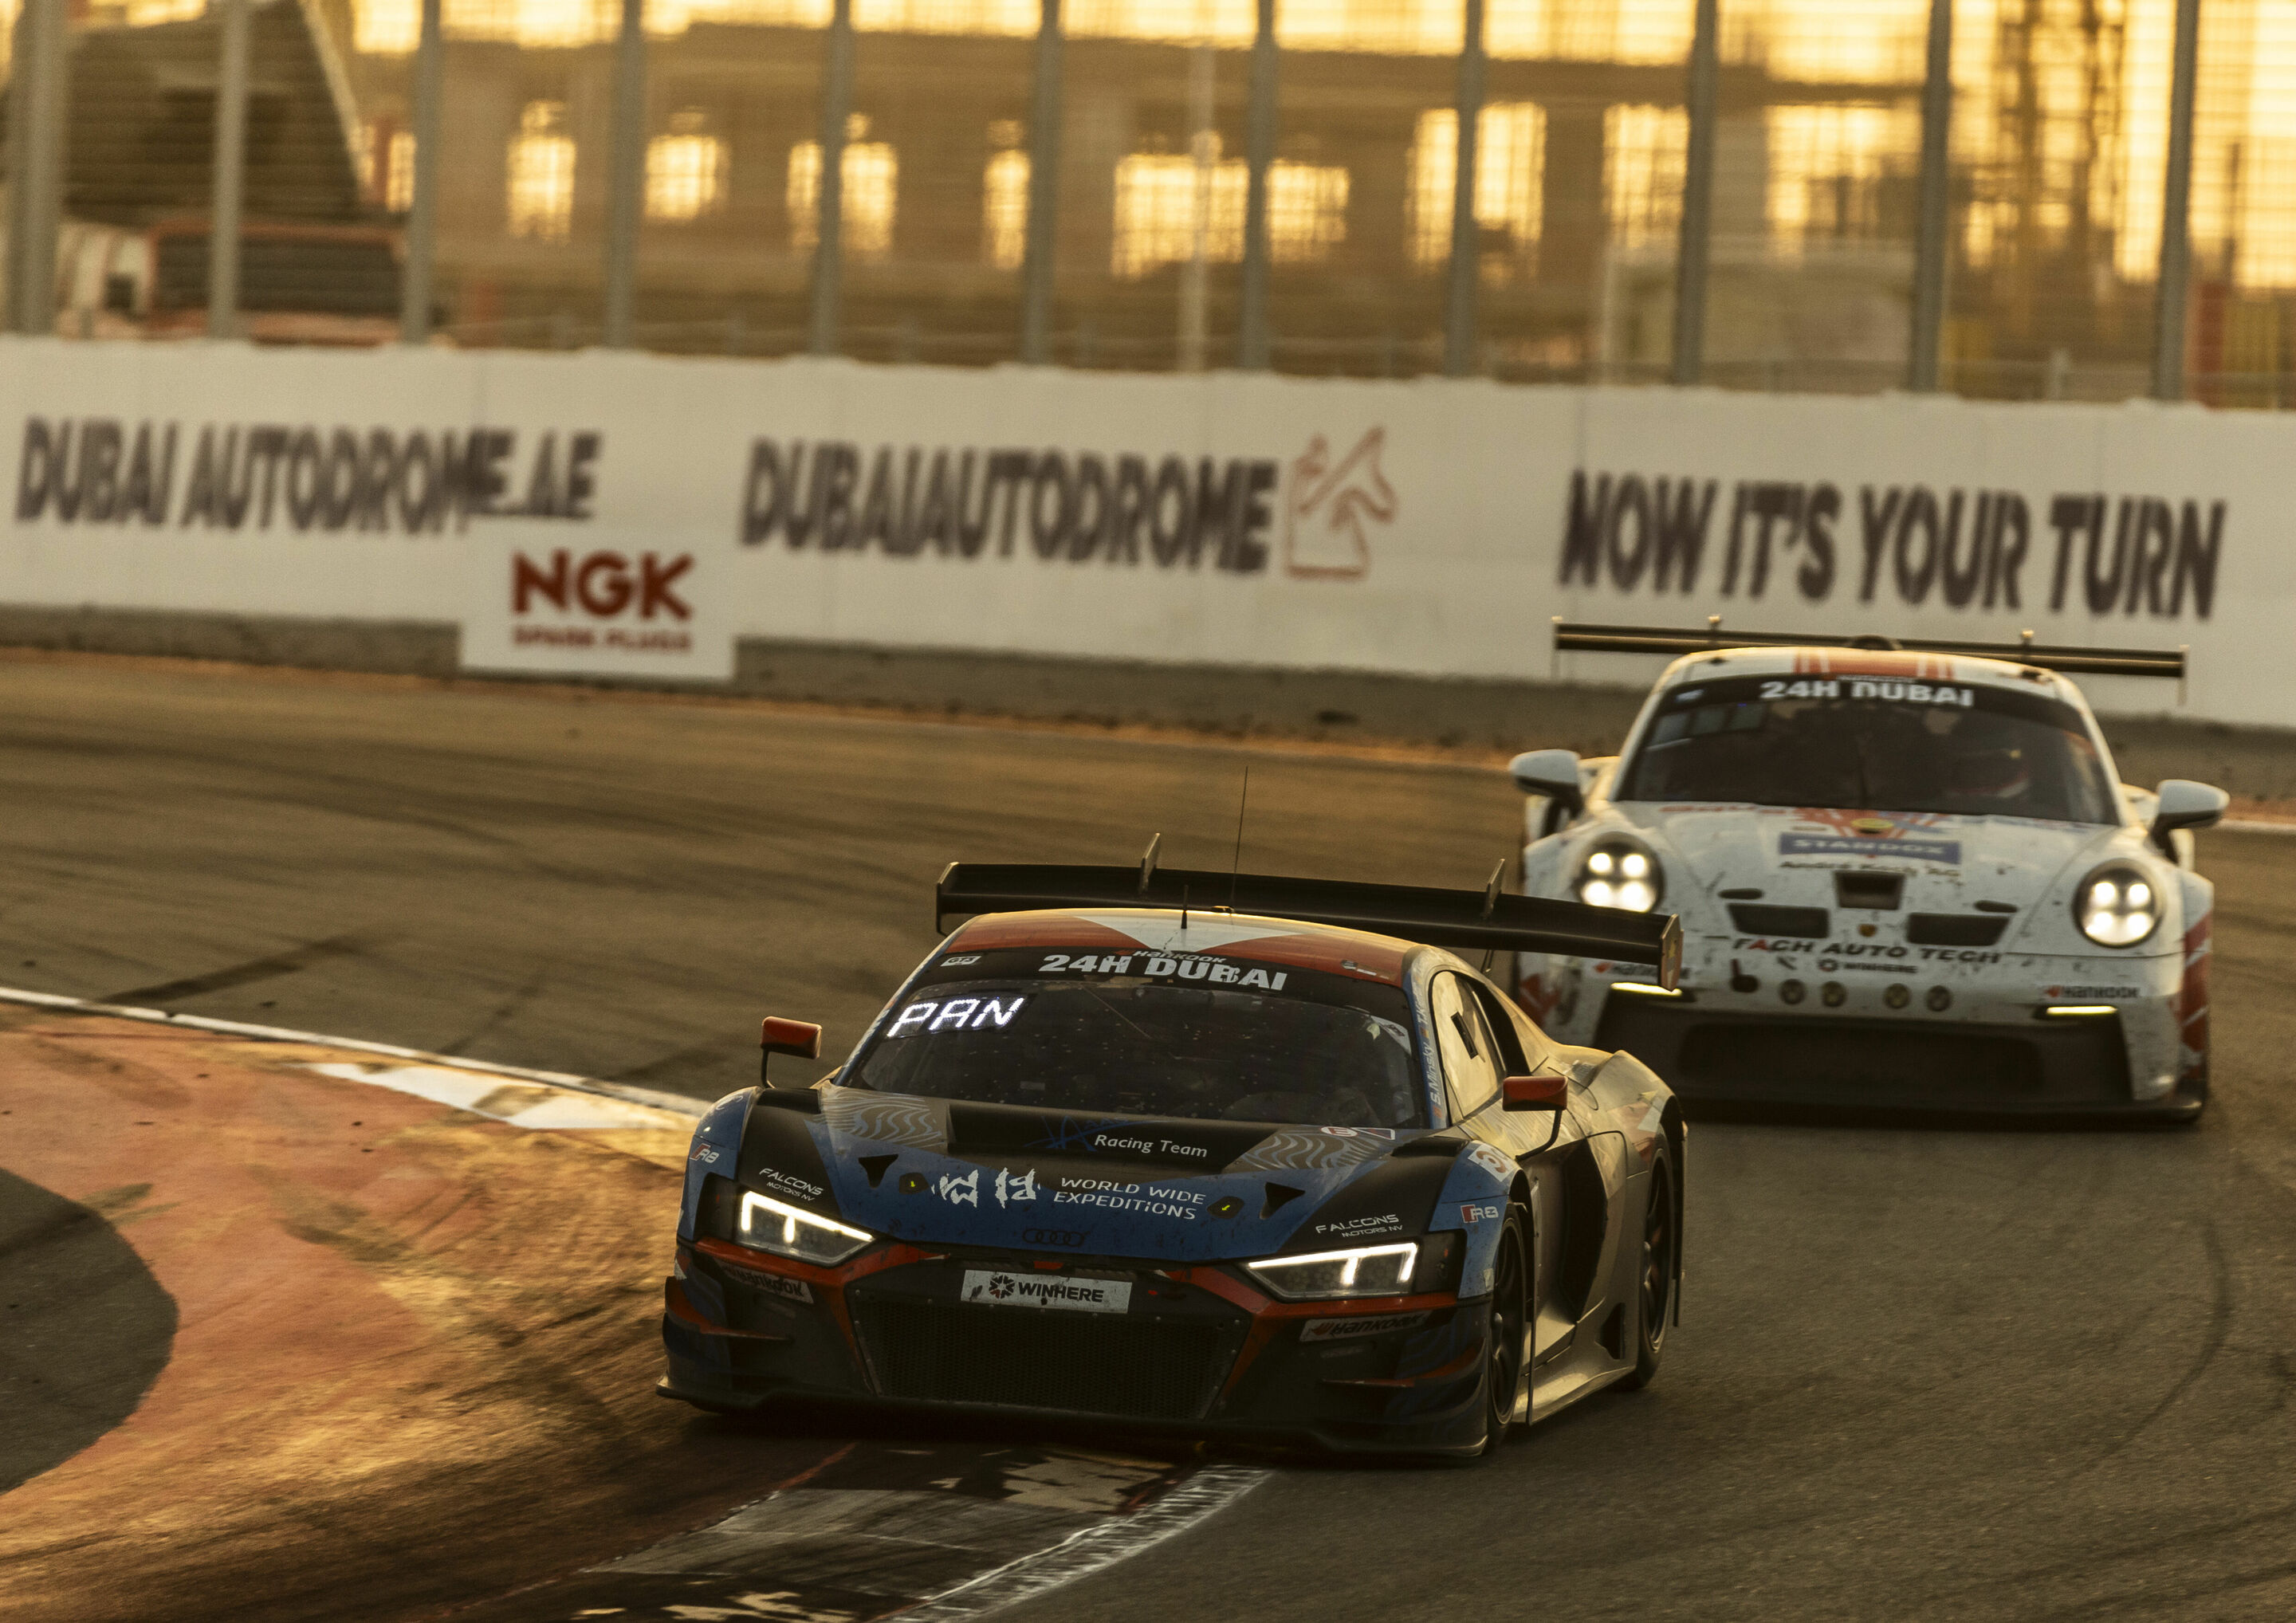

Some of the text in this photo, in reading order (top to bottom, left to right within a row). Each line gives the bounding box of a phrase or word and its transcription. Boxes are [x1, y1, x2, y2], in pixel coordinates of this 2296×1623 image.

[14, 416, 177, 526] DUBAI
[1556, 469, 2227, 622] NOW IT'S YOUR TURN
[512, 547, 695, 620] NGK
[1759, 680, 1974, 707] 24H DUBAI
[1732, 937, 2000, 965] FACH AUTO TECH
[1038, 954, 1288, 991] 24H DUBAI
[887, 997, 1024, 1037] PAN
[1095, 1134, 1208, 1157] Racing Team
[759, 1168, 824, 1196] FALCONS
[766, 1181, 816, 1202] MOTORS NV
[1061, 1177, 1140, 1194] WORLD
[1149, 1186, 1206, 1204] WIDE
[1315, 1214, 1399, 1234] FALCONS
[1469, 1204, 1499, 1220] R8
[1342, 1227, 1387, 1238] MOTORS
[1018, 1282, 1104, 1303] WINHERE
